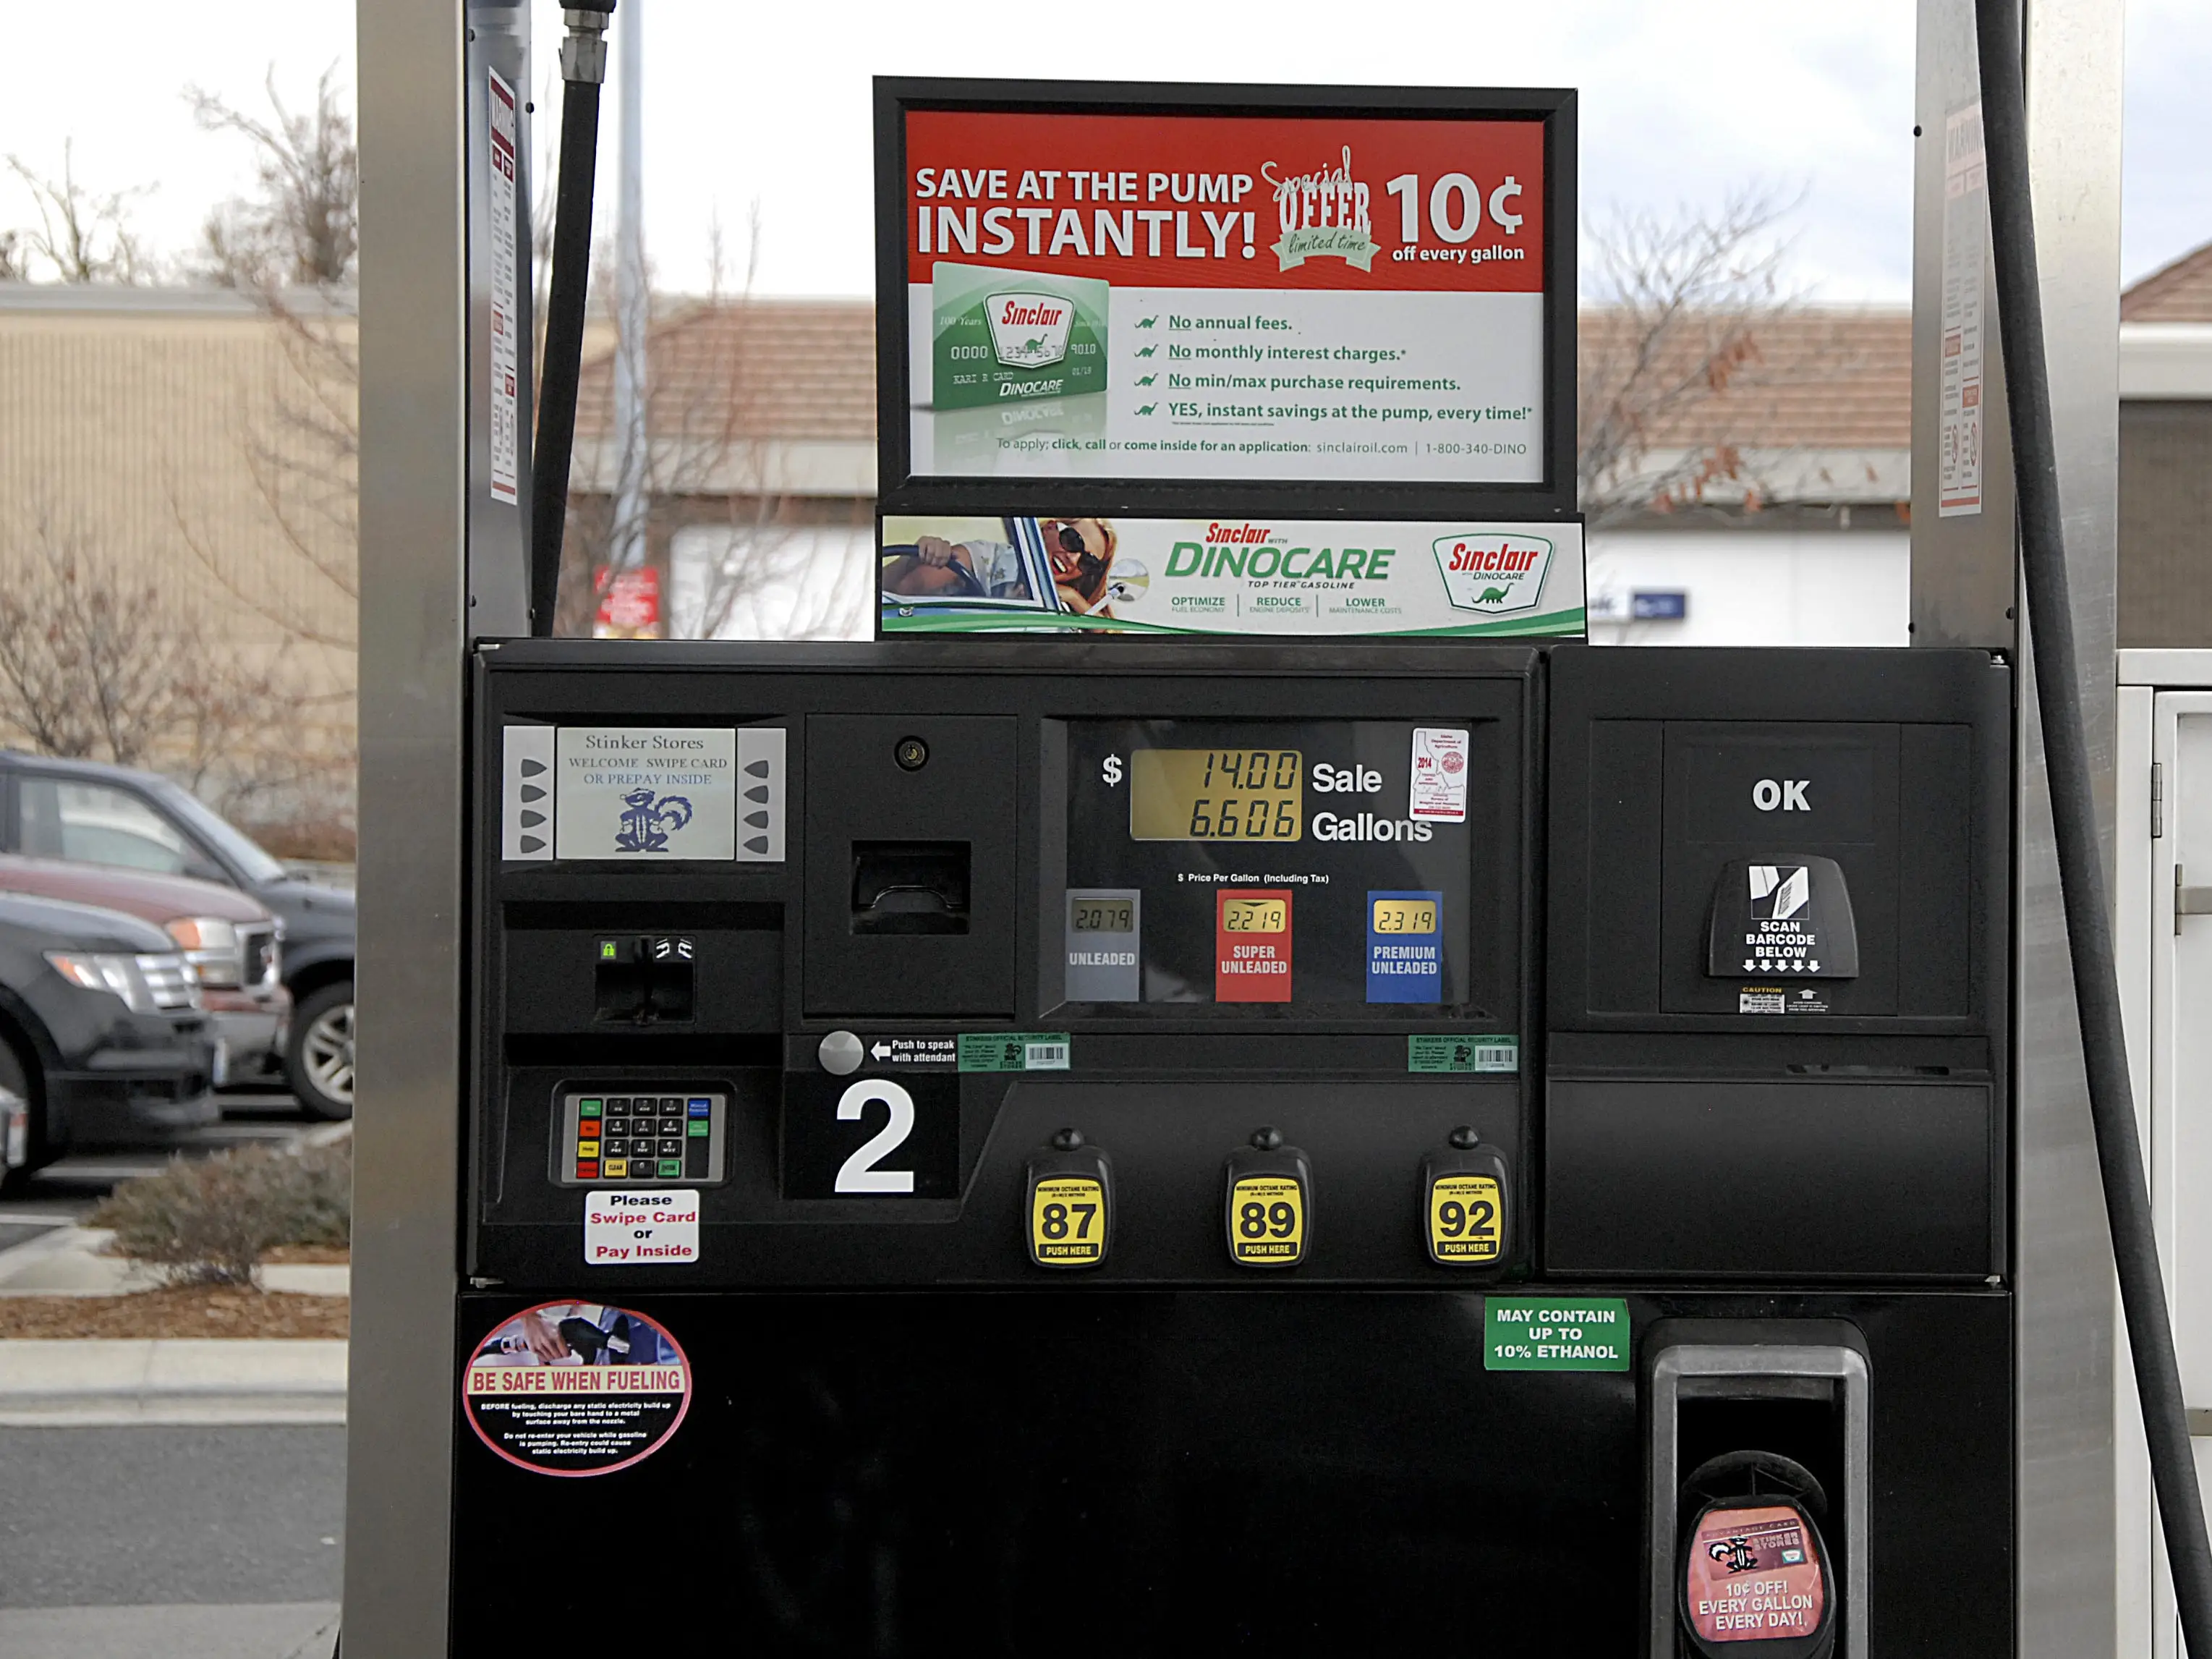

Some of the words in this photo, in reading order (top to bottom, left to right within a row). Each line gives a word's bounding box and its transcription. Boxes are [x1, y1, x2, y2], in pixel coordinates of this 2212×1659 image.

[1261, 145, 1352, 201] Special
[916, 168, 1007, 199] SAVE
[1017, 170, 1060, 200] AT
[1068, 171, 1137, 202] THE
[1148, 173, 1253, 203] PUMP
[1279, 181, 1371, 234] OFFER
[1387, 172, 1523, 244] 10¢
[918, 205, 1256, 259] INSTANTLY!
[1288, 229, 1332, 254] limited
[1337, 232, 1366, 251] time
[1392, 245, 1416, 261] off
[1420, 248, 1467, 263] every
[1471, 245, 1525, 263] gallon
[960, 315, 982, 326] Years
[1002, 300, 1062, 326] Sinclair
[1169, 315, 1191, 330] No
[1195, 315, 1251, 330] annual
[1255, 315, 1293, 330] fees.
[950, 346, 988, 360] 0000
[1071, 344, 1096, 355] 9010
[1169, 344, 1191, 359] No
[1195, 344, 1263, 362] monthly
[1267, 345, 1329, 360] interest
[999, 379, 1064, 396] DINOCARE
[1169, 373, 1191, 389] No
[1196, 374, 1266, 388] min/max
[1270, 375, 1344, 391] purchase
[1348, 376, 1461, 393] requirements.
[1169, 402, 1202, 418] YES,
[1207, 403, 1263, 417] instant
[1267, 404, 1327, 421] savings
[1332, 406, 1348, 418] at
[1351, 404, 1377, 419] the
[1382, 407, 1432, 422] pump,
[1437, 407, 1481, 423] every
[996, 438, 1010, 449] To
[1052, 438, 1081, 451] click,
[1085, 438, 1106, 450] call
[1109, 441, 1121, 450] or
[1124, 441, 1157, 451] come
[1160, 439, 1197, 451] inside
[1200, 439, 1218, 451] for
[1220, 442, 1235, 451] an
[1239, 440, 1311, 454] application:
[1316, 441, 1408, 454] sinclairoil.com
[1426, 443, 1526, 454] 1-800-340-DINO
[1206, 522, 1269, 544] Sinclair
[1165, 542, 1396, 579] DINOCARE
[1449, 543, 1538, 571] Sinclair
[1473, 572, 1526, 580] DINOCARE
[1172, 597, 1225, 606] OPTIMIZE
[1256, 597, 1301, 606] REDUCE
[1345, 598, 1384, 607] LOWER
[586, 736, 647, 750] Stinker
[652, 736, 704, 750] Stores
[569, 758, 638, 768] WELCOME
[647, 758, 686, 768] SWIPE
[691, 758, 727, 768] CARD
[1102, 753, 1123, 787] $
[1204, 752, 1298, 790] 14.00
[1418, 758, 1432, 768] 2014
[584, 774, 603, 784] OR
[608, 774, 662, 785] PREPAY
[666, 774, 712, 785] INSIDE
[1312, 763, 1382, 792] Sale
[1753, 778, 1811, 811] OK
[1189, 799, 1294, 838] 6.606
[1312, 812, 1433, 841] Gallons
[1230, 874, 1259, 883] Gallon
[1264, 874, 1308, 884] (Including
[1311, 874, 1329, 883] Tax)
[1228, 910, 1281, 930] 2.219
[1379, 910, 1432, 932] 2.319
[1761, 922, 1800, 933] SCAN
[1745, 934, 1816, 946] BARCODE
[1069, 952, 1135, 966] UNLEADED
[1233, 946, 1276, 959] SUPER
[1373, 946, 1436, 959] PREMIUM
[1755, 946, 1807, 957] BELOW
[1220, 961, 1287, 974] UNLEADED
[1371, 962, 1437, 975] UNLEADED
[892, 1040, 914, 1049] Push
[916, 1040, 925, 1049] to
[928, 1040, 954, 1051] speak
[892, 1053, 911, 1063] with
[913, 1053, 956, 1063] attendant
[834, 1078, 915, 1193] 2
[611, 1195, 672, 1207] Please
[590, 1212, 647, 1226] Swipe
[653, 1211, 697, 1223] Card
[1041, 1202, 1097, 1240] 87
[1240, 1201, 1296, 1239] 89
[1439, 1200, 1494, 1238] 92
[634, 1229, 652, 1239] or
[596, 1246, 629, 1260] Pay
[637, 1244, 692, 1257] Inside
[1046, 1245, 1068, 1256] PUSH
[1070, 1244, 1092, 1256] HERE
[1245, 1244, 1267, 1255] PUSH
[1269, 1244, 1290, 1255] HERE
[1445, 1244, 1466, 1253] PUSH
[1468, 1243, 1489, 1252] HERE
[1497, 1310, 1533, 1323] MAY
[1539, 1310, 1615, 1323] CONTAIN
[1528, 1328, 1553, 1340] UP
[1558, 1328, 1582, 1340] TO
[1494, 1345, 1531, 1358] 10%
[1537, 1345, 1618, 1359] ETHANOL
[473, 1372, 496, 1391] BE
[501, 1372, 545, 1391] SAFE
[551, 1371, 601, 1391] WHEN
[607, 1370, 680, 1390] FUELING
[1727, 1583, 1751, 1597] 10¢
[1754, 1580, 1787, 1595] OFF!
[1699, 1598, 1748, 1615] EVERY
[1752, 1595, 1813, 1611] GALLON
[1716, 1614, 1764, 1630] EVERY
[1769, 1611, 1803, 1627] DAY!
